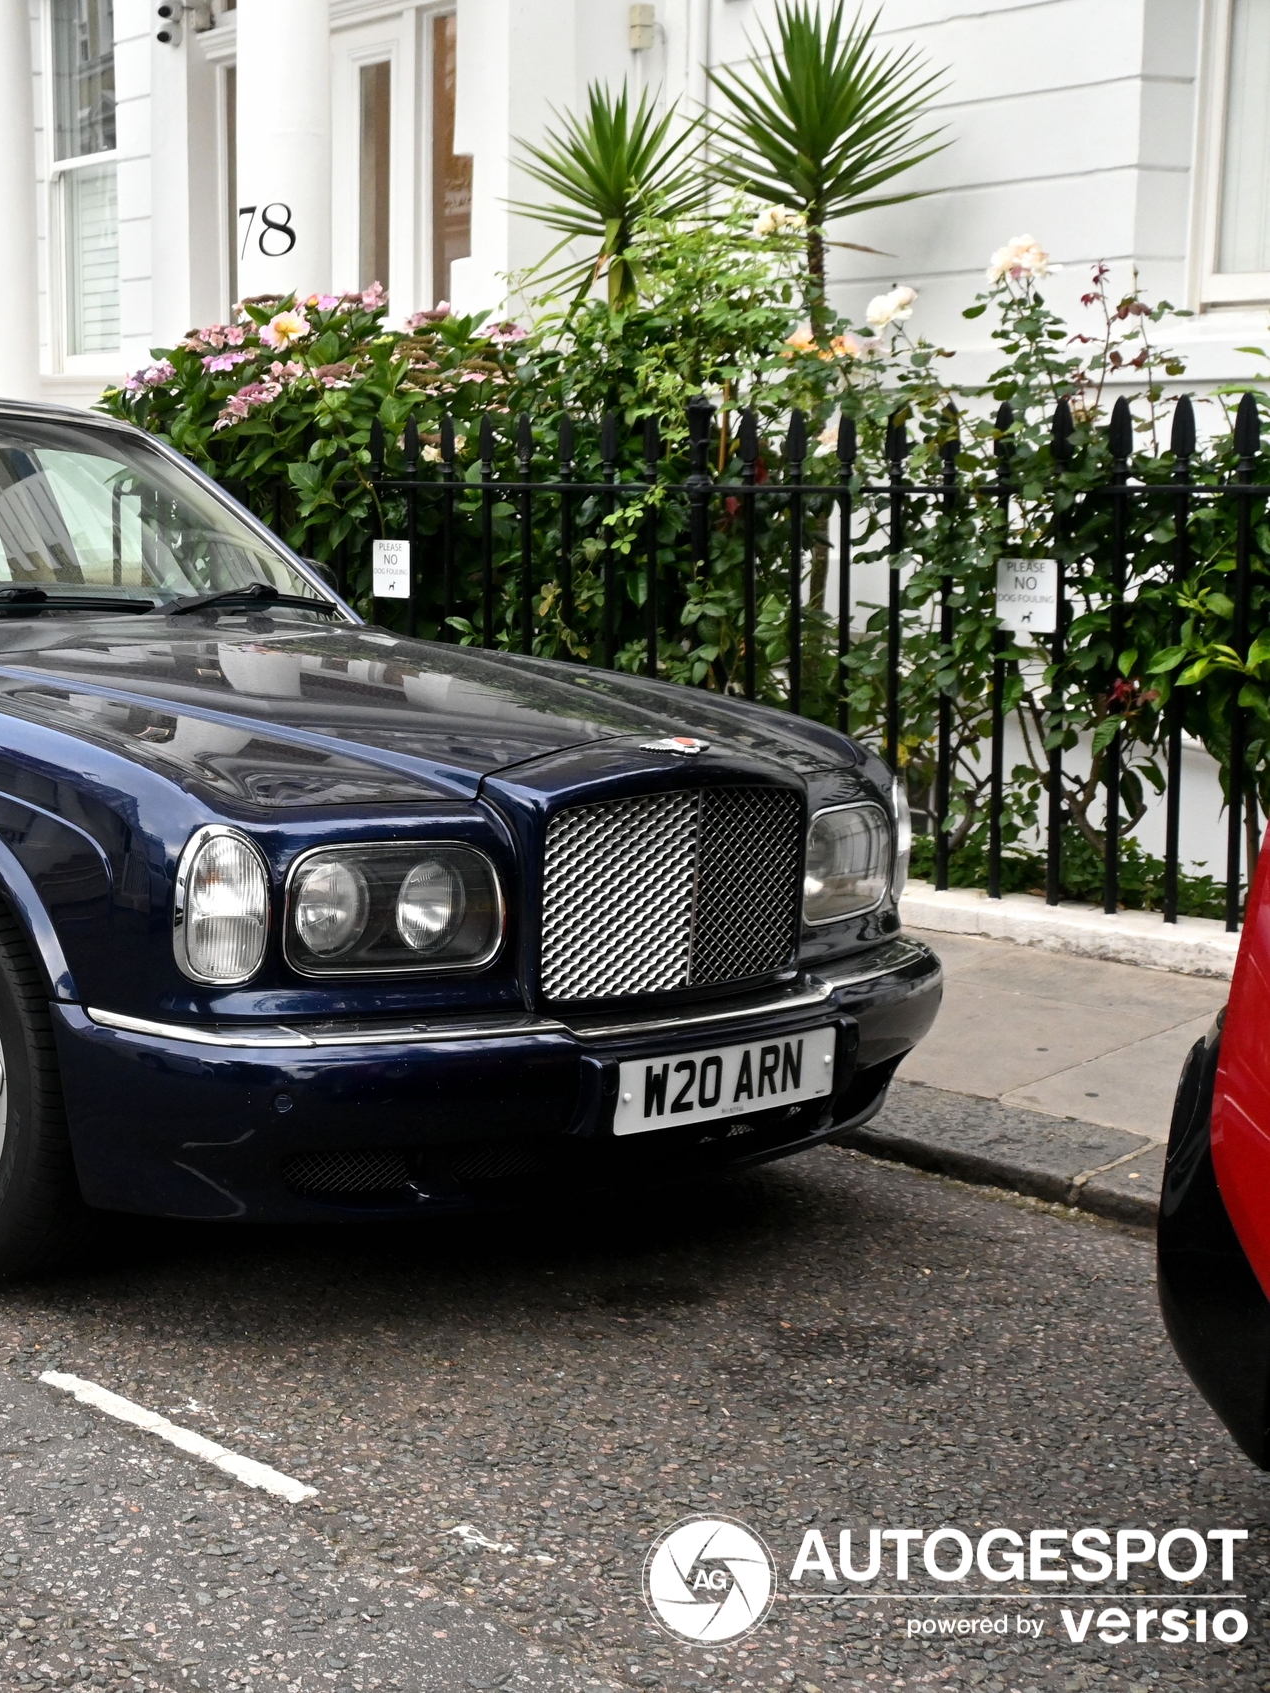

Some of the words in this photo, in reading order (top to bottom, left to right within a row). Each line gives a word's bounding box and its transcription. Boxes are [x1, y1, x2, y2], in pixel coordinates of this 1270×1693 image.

[238, 202, 297, 261] 78
[379, 542, 402, 551] PLEASE
[383, 553, 398, 565] NO
[1006, 561, 1045, 572] PLEASE
[1014, 576, 1038, 591] NO
[998, 593, 1016, 602] DOG
[1017, 594, 1054, 603] FOULING
[644, 1055, 723, 1118] W20
[733, 1039, 804, 1103] ARN
